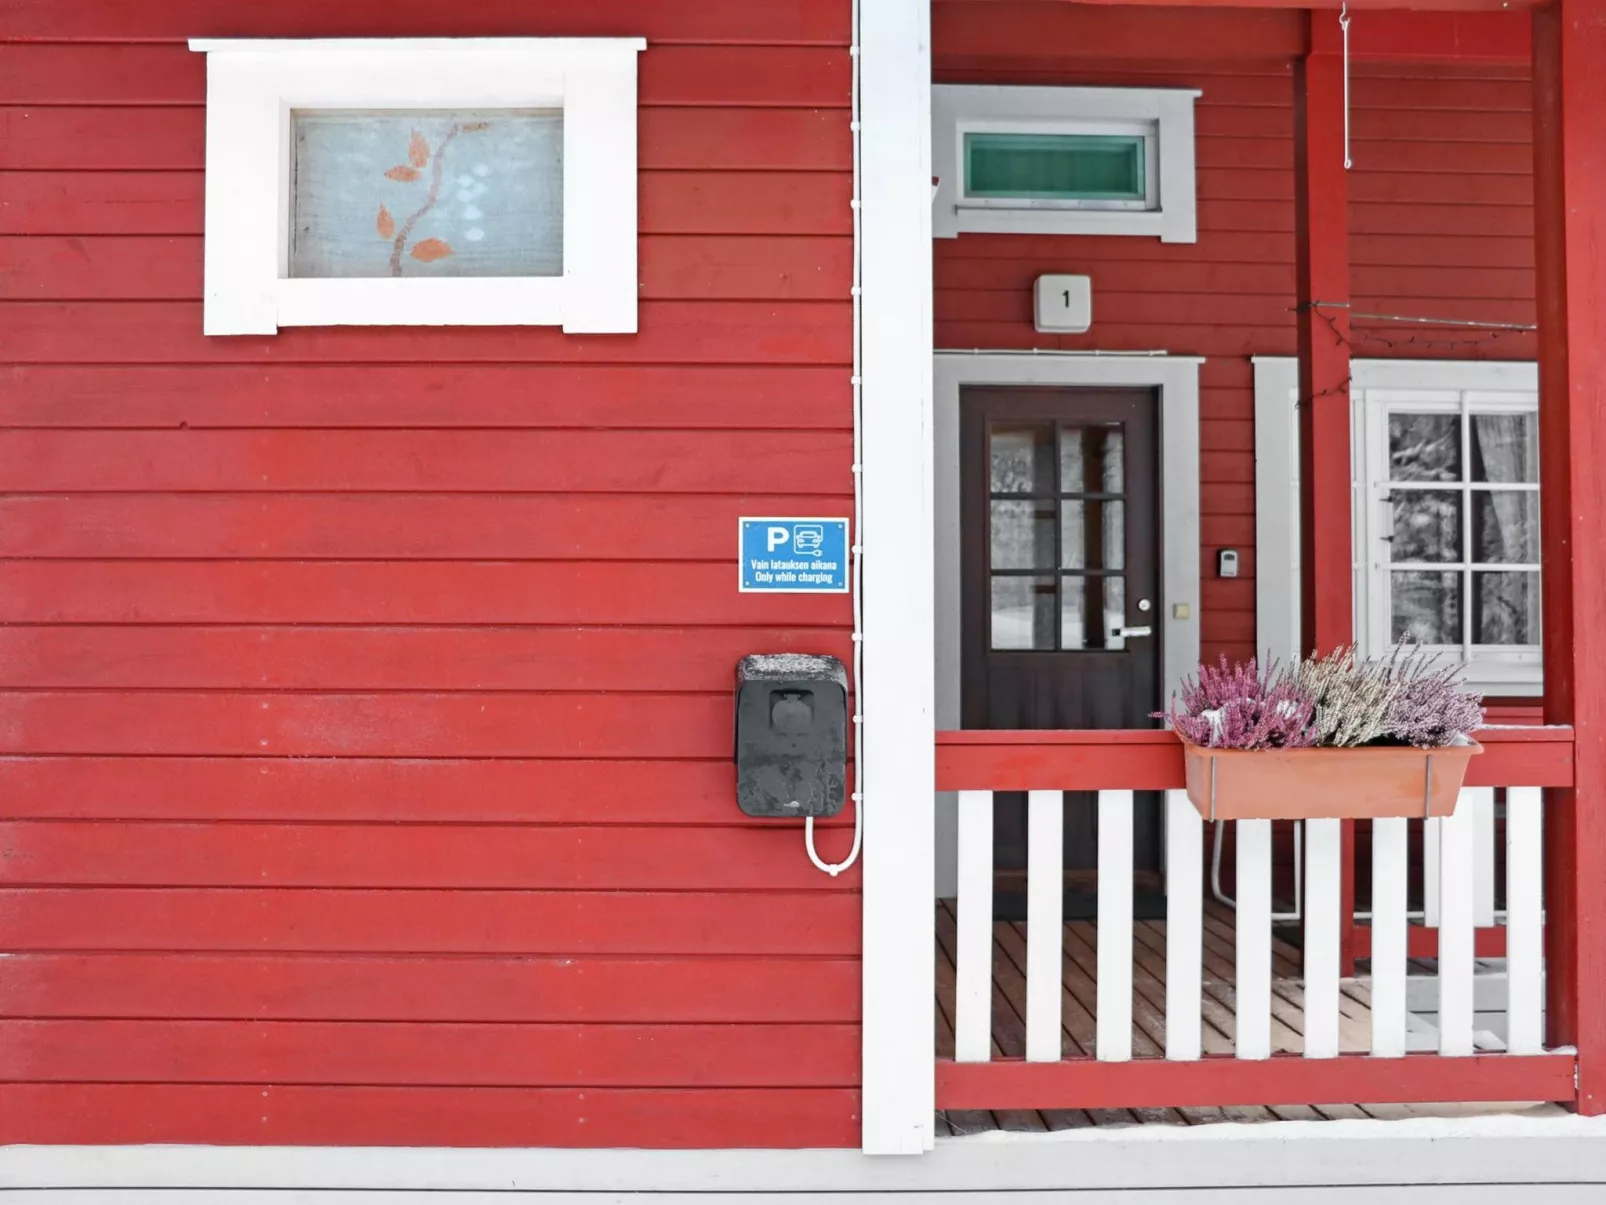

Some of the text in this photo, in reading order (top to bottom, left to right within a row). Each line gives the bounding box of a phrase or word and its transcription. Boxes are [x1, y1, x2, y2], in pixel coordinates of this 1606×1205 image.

[1062, 289, 1070, 308] 1
[767, 526, 790, 552] P
[751, 559, 837, 570] Vain latauksen aikana
[755, 571, 833, 584] Only while charging
